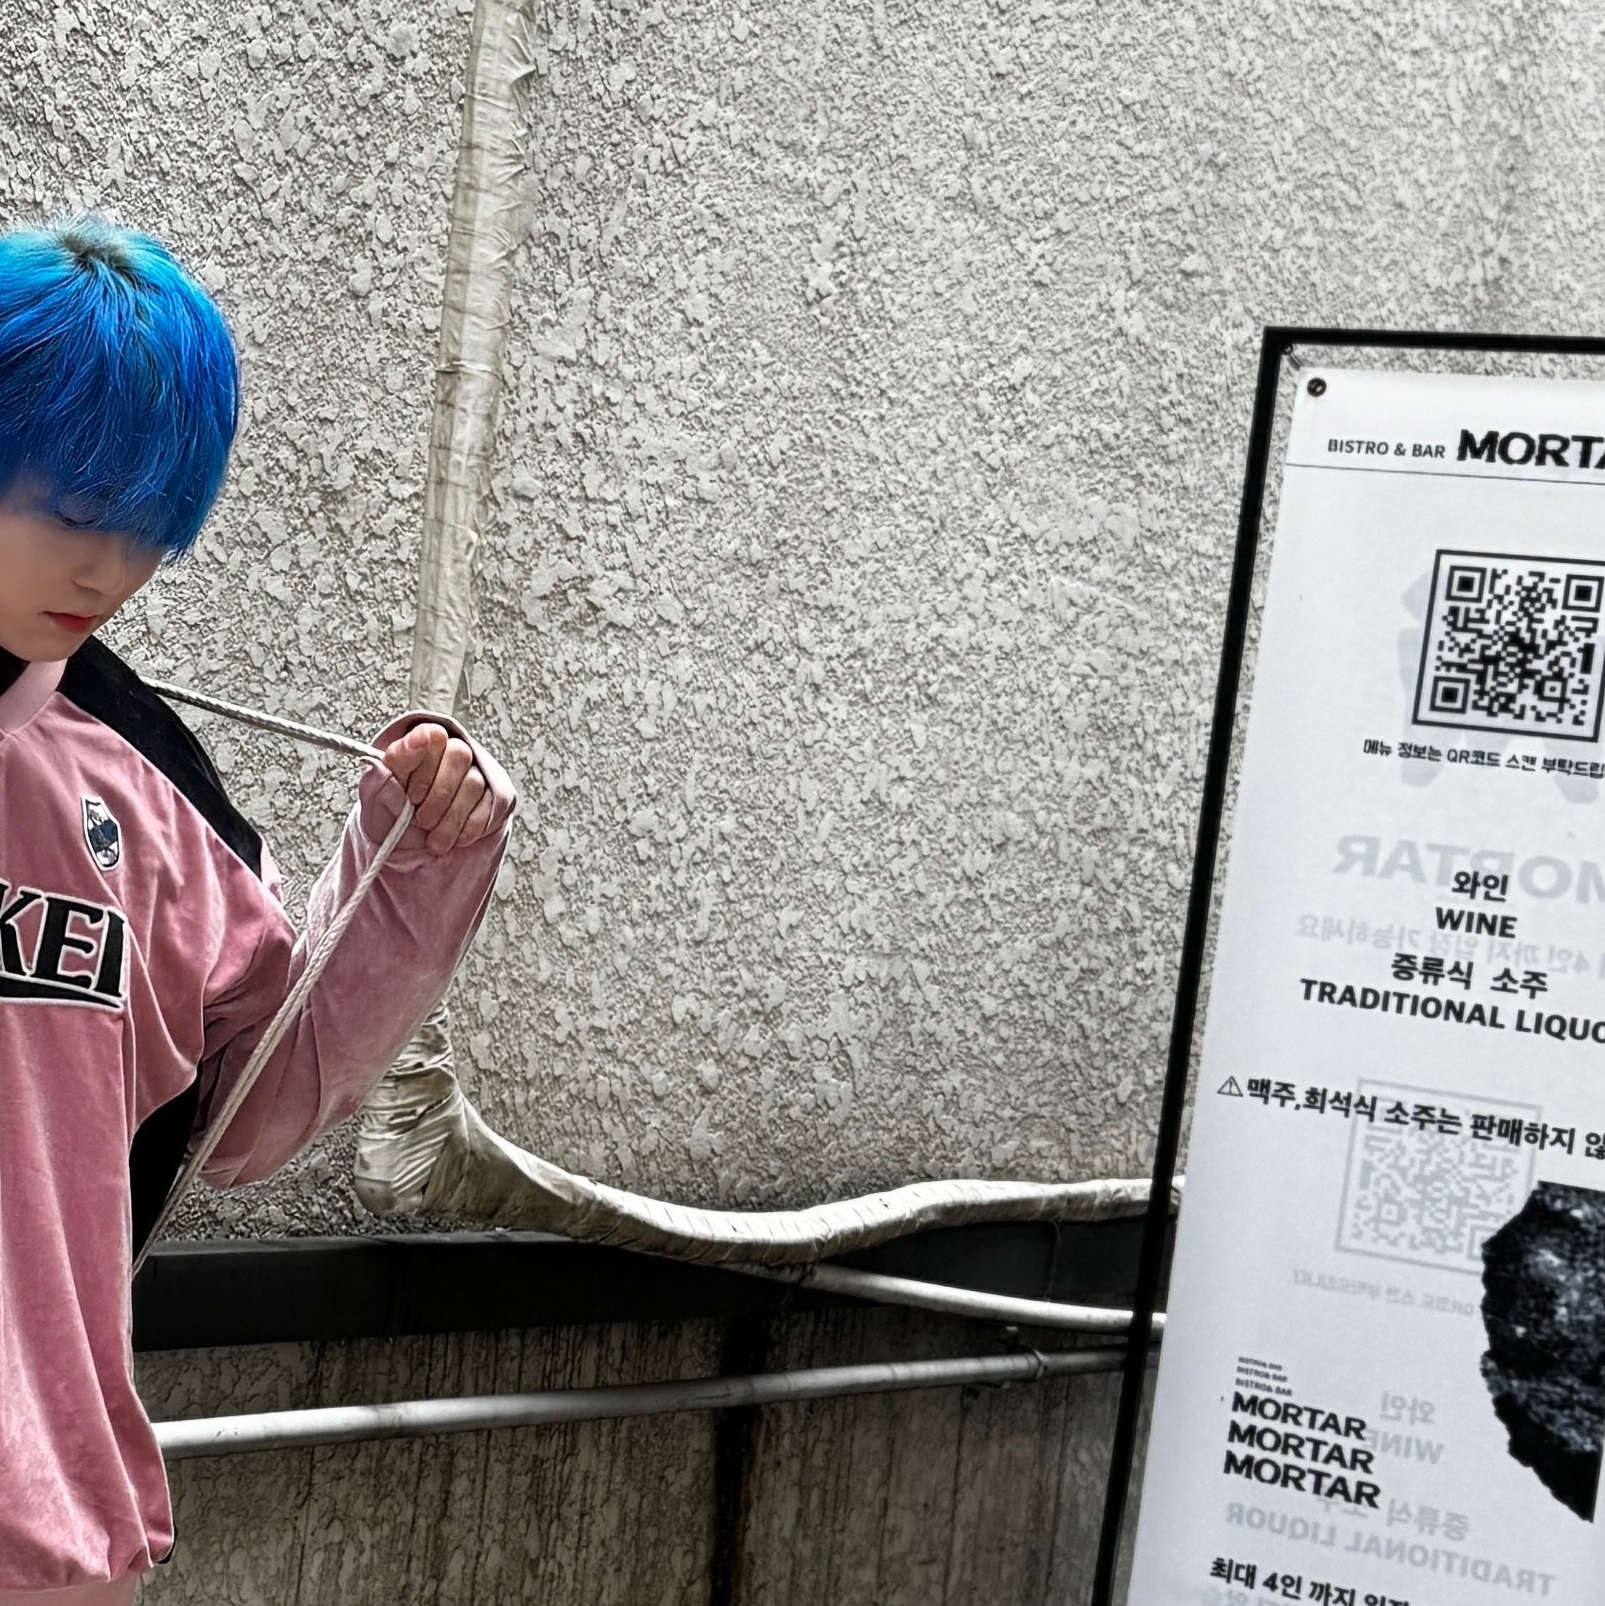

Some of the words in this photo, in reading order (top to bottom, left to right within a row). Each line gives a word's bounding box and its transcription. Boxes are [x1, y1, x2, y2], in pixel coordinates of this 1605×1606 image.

[1328, 439, 1388, 455] BISTRO
[1394, 443, 1406, 456] &
[1412, 444, 1445, 458] BAR
[1363, 739, 1392, 756] 메뉴
[1399, 743, 1442, 762] 정보는
[1447, 749, 1500, 766] QR코드
[1506, 755, 1536, 771] 스캔
[1452, 871, 1508, 902] 와인
[1436, 907, 1517, 938] WINE
[1392, 953, 1473, 990] 증류식
[1491, 968, 1547, 999] 소주
[1301, 979, 1504, 1029] TRADITIONAL
[1384, 1101, 1462, 1135] 소주는
[1470, 1114, 1575, 1154] 판매하지
[1232, 1390, 1366, 1440] MORTAR
[1228, 1419, 1374, 1474] MORTAR
[1224, 1449, 1380, 1508] MORTAR
[1210, 1557, 1257, 1589] 최대
[1263, 1573, 1302, 1600] 4인
